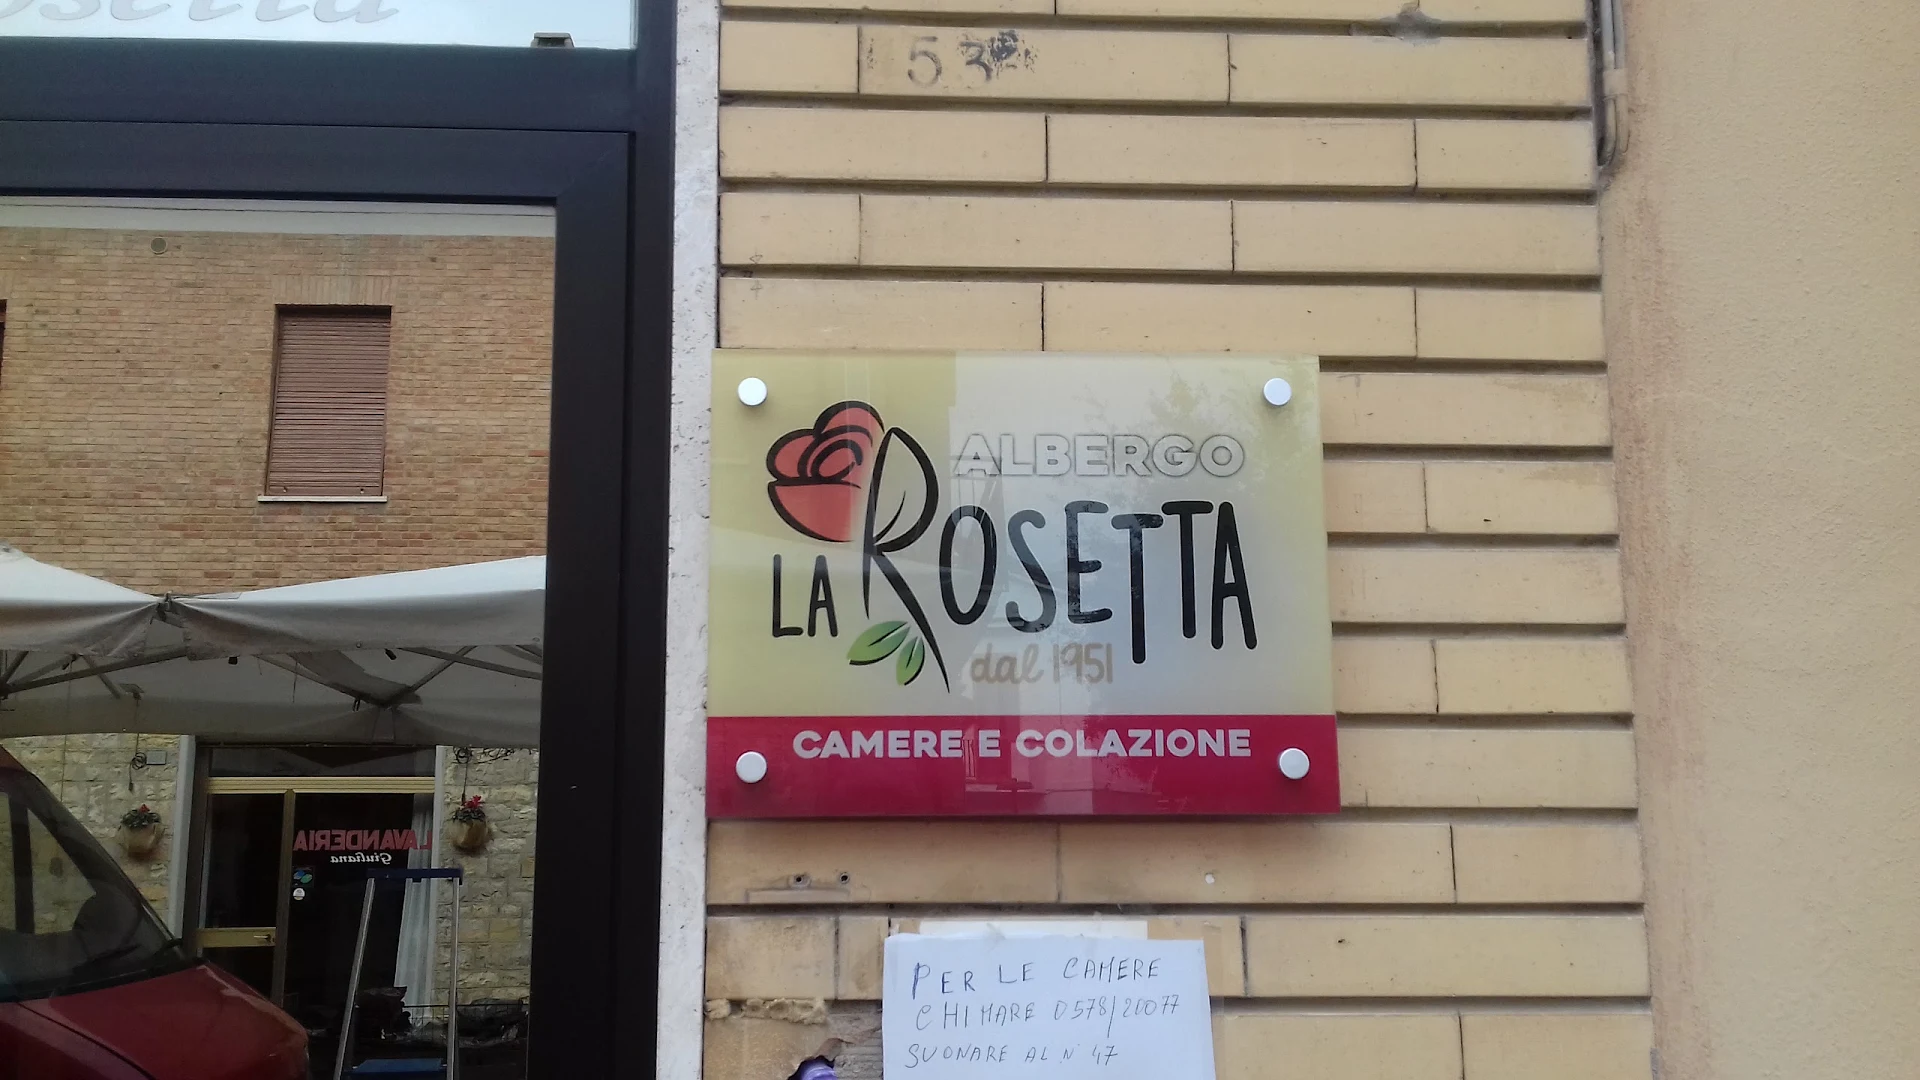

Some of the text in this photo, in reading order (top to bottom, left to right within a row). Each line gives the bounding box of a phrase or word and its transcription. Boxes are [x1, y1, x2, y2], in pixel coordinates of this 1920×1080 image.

[953, 434, 1245, 477] ALBERGO
[772, 427, 1258, 694] LA ROSETTA
[970, 643, 1114, 685] dal 1951
[792, 729, 1252, 758] CAMERE E COLAZIONE
[911, 957, 1161, 999] PER LE CAMERE
[905, 1043, 1008, 1068] SUONARE
[1025, 1047, 1048, 1062] AL
